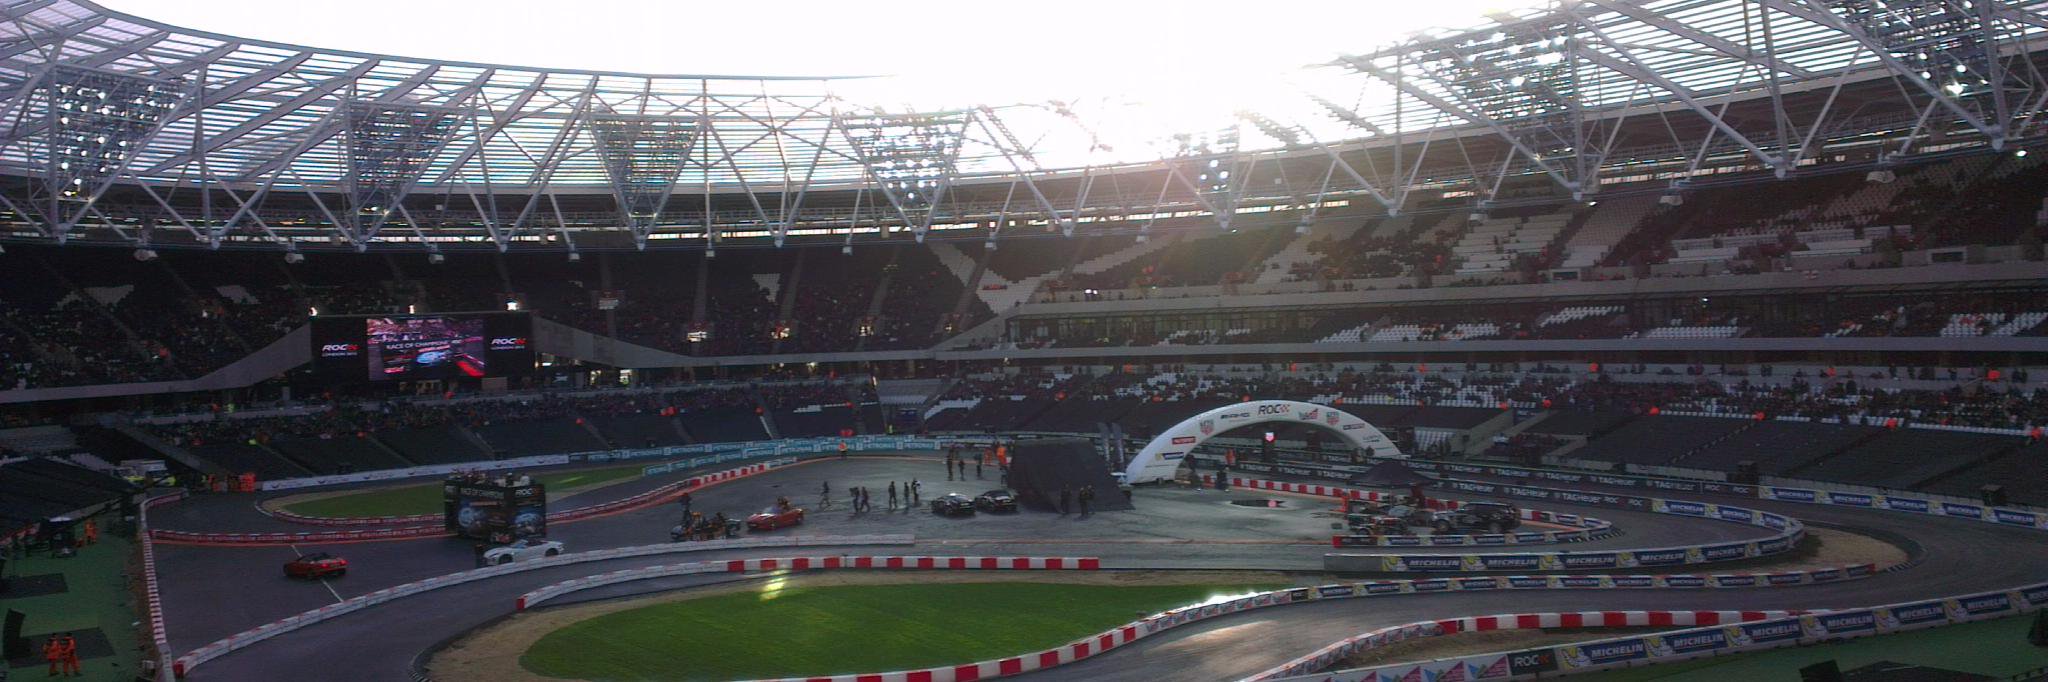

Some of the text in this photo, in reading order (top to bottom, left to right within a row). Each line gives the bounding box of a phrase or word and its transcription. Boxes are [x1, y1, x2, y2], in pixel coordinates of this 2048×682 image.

[1258, 404, 1281, 415] ROC
[1409, 559, 1460, 567] MICHELIN
[1641, 552, 1684, 561] MICHELIN
[1968, 598, 2008, 611] MICHELIN
[1900, 606, 1943, 619] MICHELIN
[1827, 614, 1874, 627] MICHELIN
[1752, 623, 1798, 639] MICHELIN
[1674, 632, 1724, 648] MICHELIN
[1591, 643, 1643, 658] MICHELIN
[1514, 654, 1542, 668] ROC
